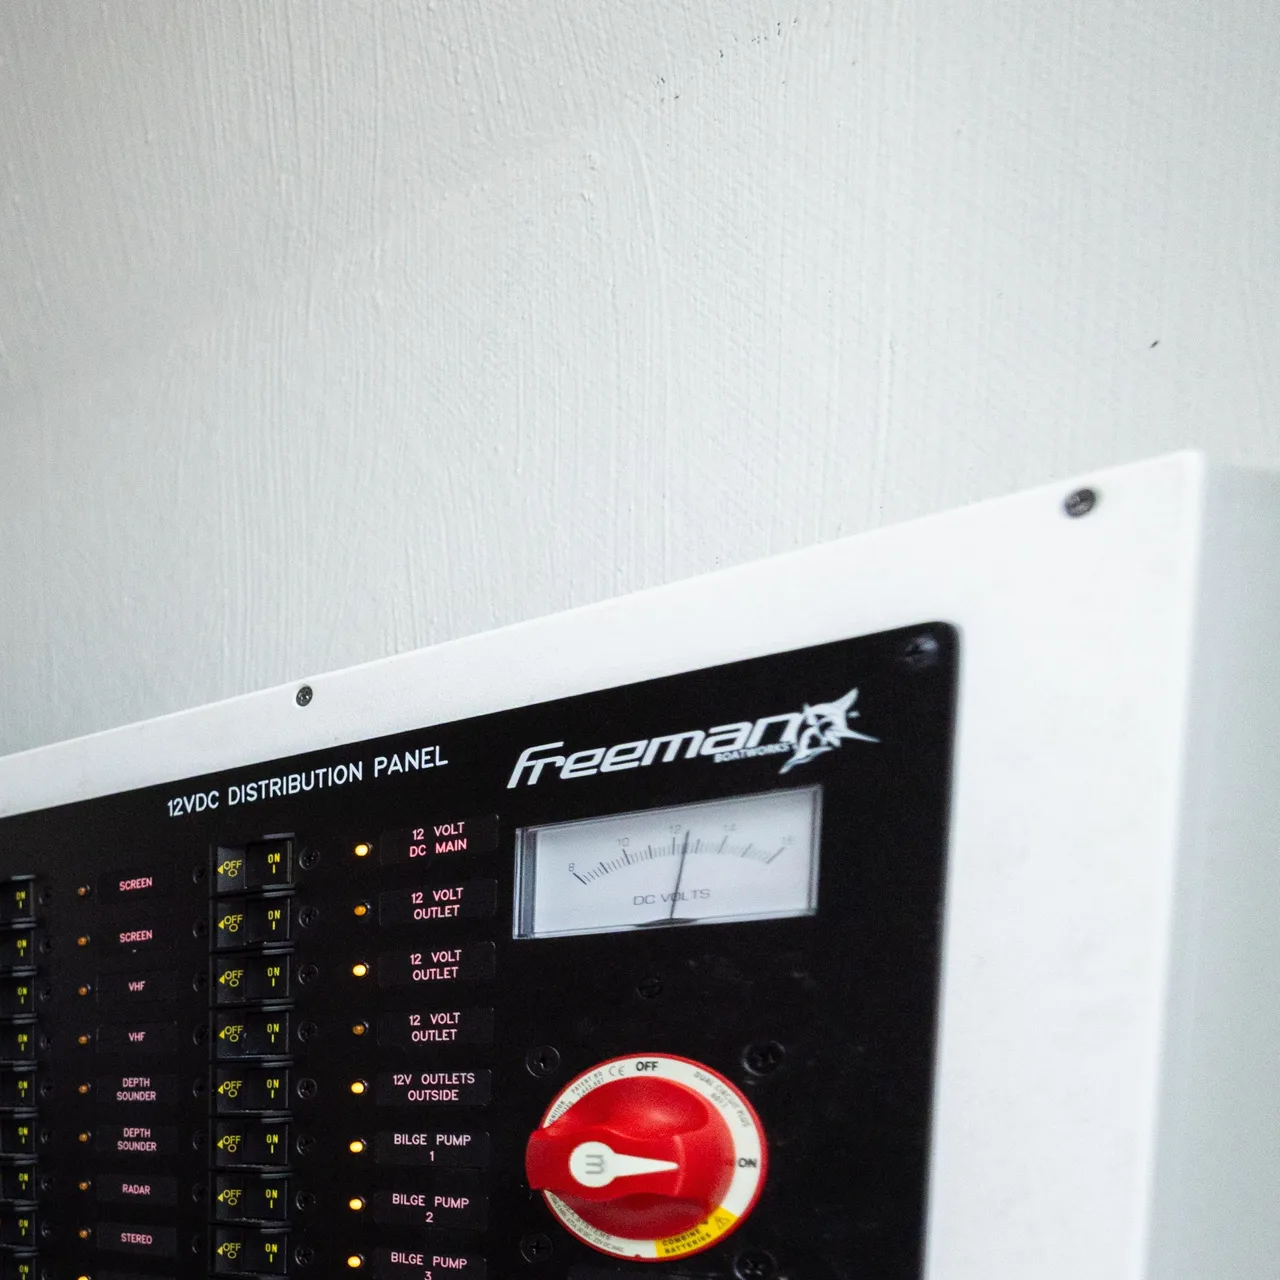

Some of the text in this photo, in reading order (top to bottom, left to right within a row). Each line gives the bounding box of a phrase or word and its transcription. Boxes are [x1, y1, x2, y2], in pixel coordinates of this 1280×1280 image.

[506, 712, 801, 789] Freeman
[167, 745, 449, 817] 12VDC DISTRIBUTION PANEL
[413, 823, 464, 841] 12 VOLT
[617, 837, 629, 847] 10
[409, 838, 468, 858] DC MAIN
[268, 853, 280, 863] ON
[223, 860, 242, 870] OFF
[568, 862, 575, 871] 8
[119, 877, 152, 891] SCREEN
[16, 891, 26, 901] ON
[411, 888, 464, 905] 12 VOLT
[633, 889, 711, 906] DC VOLTS
[268, 910, 280, 919] ON
[413, 904, 461, 920] OUTLET
[224, 914, 243, 925] OFF
[120, 930, 152, 943] SCREEN
[16, 939, 28, 949] ON
[410, 950, 461, 966] 12 VOLT
[225, 970, 243, 980] OFF
[268, 967, 280, 976] ON
[412, 966, 459, 981] OUTLET
[129, 981, 146, 991] VHF
[17, 987, 28, 996] ON
[409, 1012, 459, 1027] 12 VOLT
[225, 1025, 243, 1035] OFF
[267, 1023, 279, 1032] ON
[17, 1034, 28, 1043] ON
[129, 1032, 146, 1042] VHF
[412, 1029, 458, 1043] OUTLET
[636, 1061, 659, 1072] OFF
[18, 1080, 29, 1089] ON
[123, 1078, 150, 1087] DEPTH
[267, 1079, 279, 1088] ON
[393, 1073, 474, 1086] 12V OUTLETS
[223, 1080, 242, 1090] OFF
[117, 1091, 157, 1101] SOUNDER
[408, 1089, 459, 1102] OUTSIDE
[18, 1127, 29, 1136] ON
[123, 1128, 151, 1137] DEPTH
[223, 1135, 241, 1145] OFF
[267, 1134, 278, 1143] ON
[393, 1134, 471, 1146] BILGE PUMP
[118, 1141, 157, 1151] SOUNDER
[429, 1151, 435, 1162] 1
[738, 1158, 757, 1168] ON
[122, 1184, 151, 1194] RADAR
[223, 1189, 242, 1199] OFF
[266, 1189, 277, 1198] ON
[392, 1194, 470, 1209] BILGE PUMP
[425, 1212, 434, 1223] 2
[121, 1233, 153, 1244] STEREO
[662, 1228, 700, 1247] COMBINE
[223, 1242, 241, 1252] OFF
[664, 1232, 712, 1254] BATTERIES
[265, 1244, 277, 1253] ON
[390, 1252, 467, 1270] BILGE PUMP
